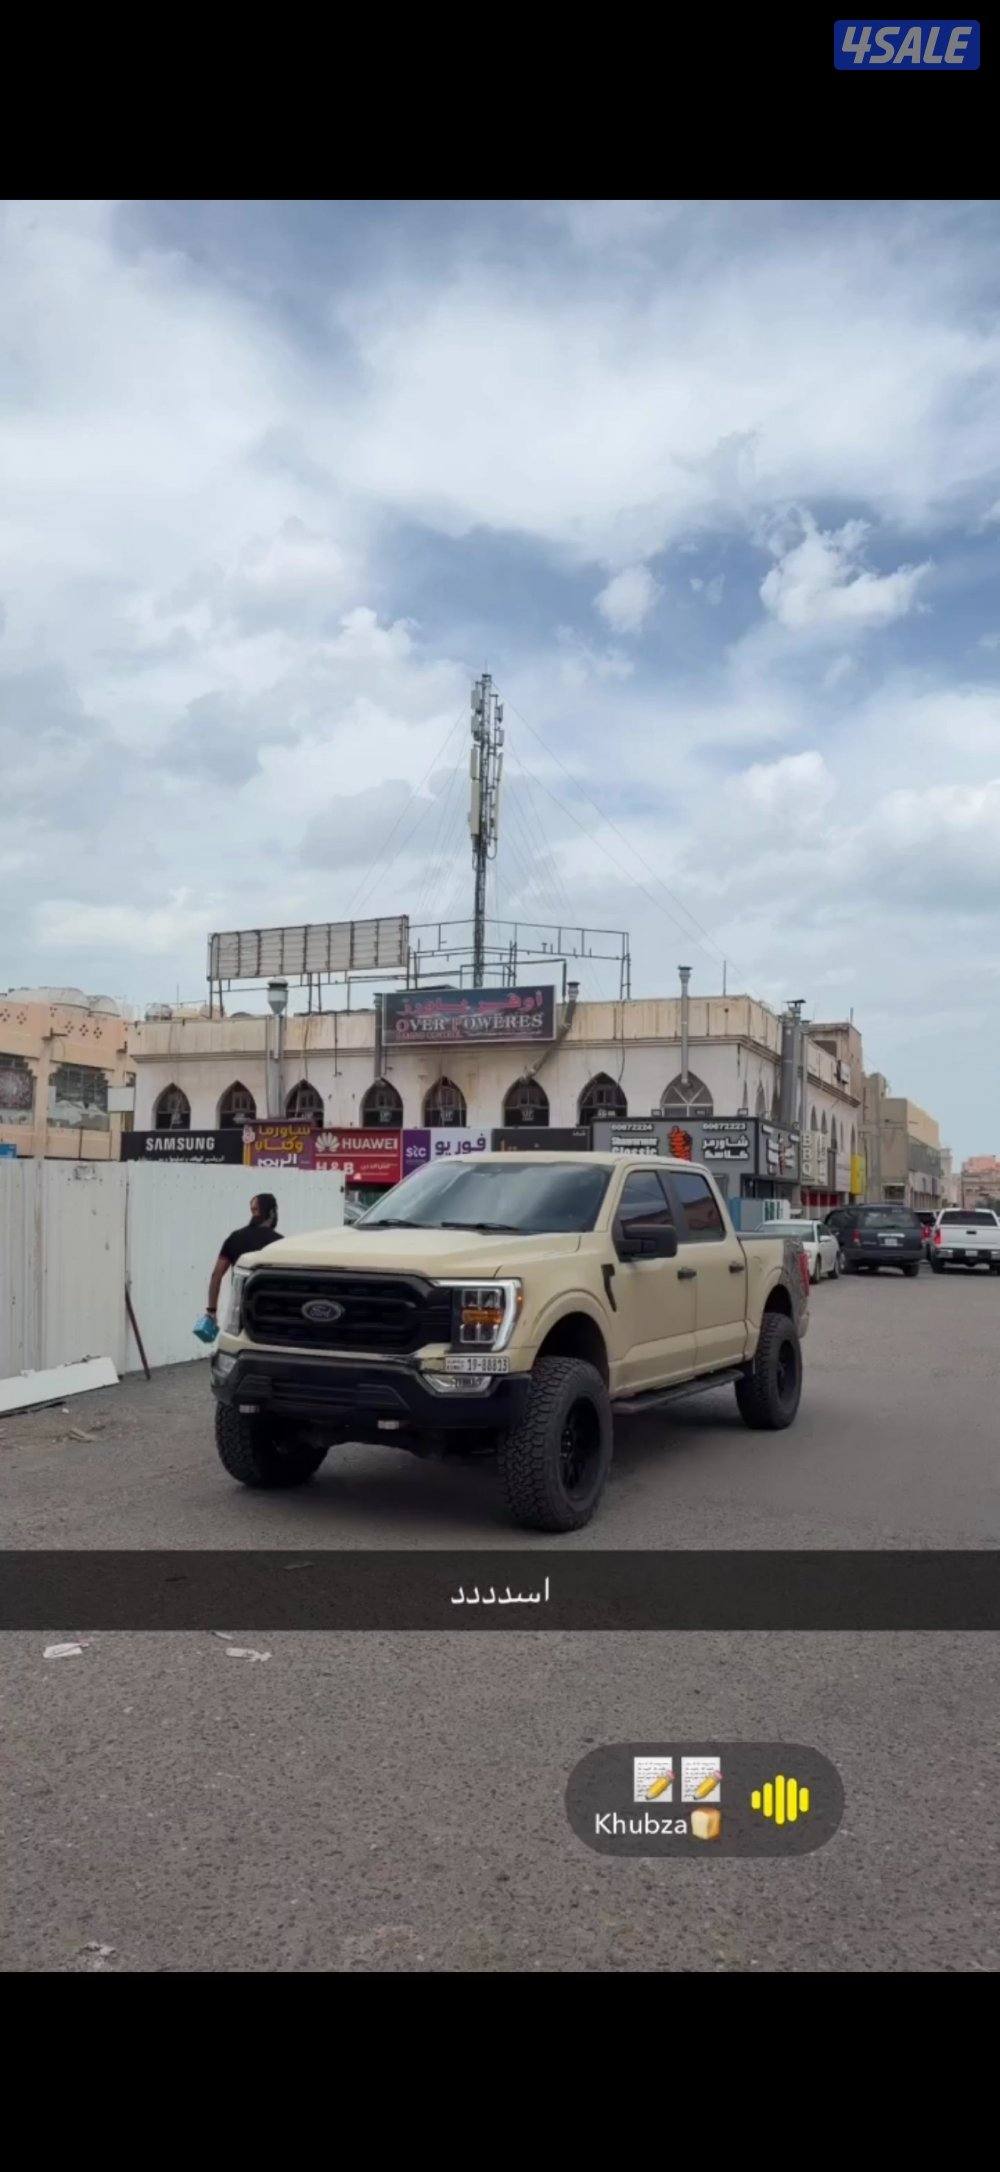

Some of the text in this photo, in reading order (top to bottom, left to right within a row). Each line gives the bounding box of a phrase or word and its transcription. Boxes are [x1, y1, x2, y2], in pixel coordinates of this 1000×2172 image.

[395, 1018, 446, 1033] OVER
[145, 1136, 215, 1151] SAMSUNG
[342, 1137, 398, 1150] HUAWEI
[405, 1145, 427, 1158] stc
[343, 1162, 354, 1175] B
